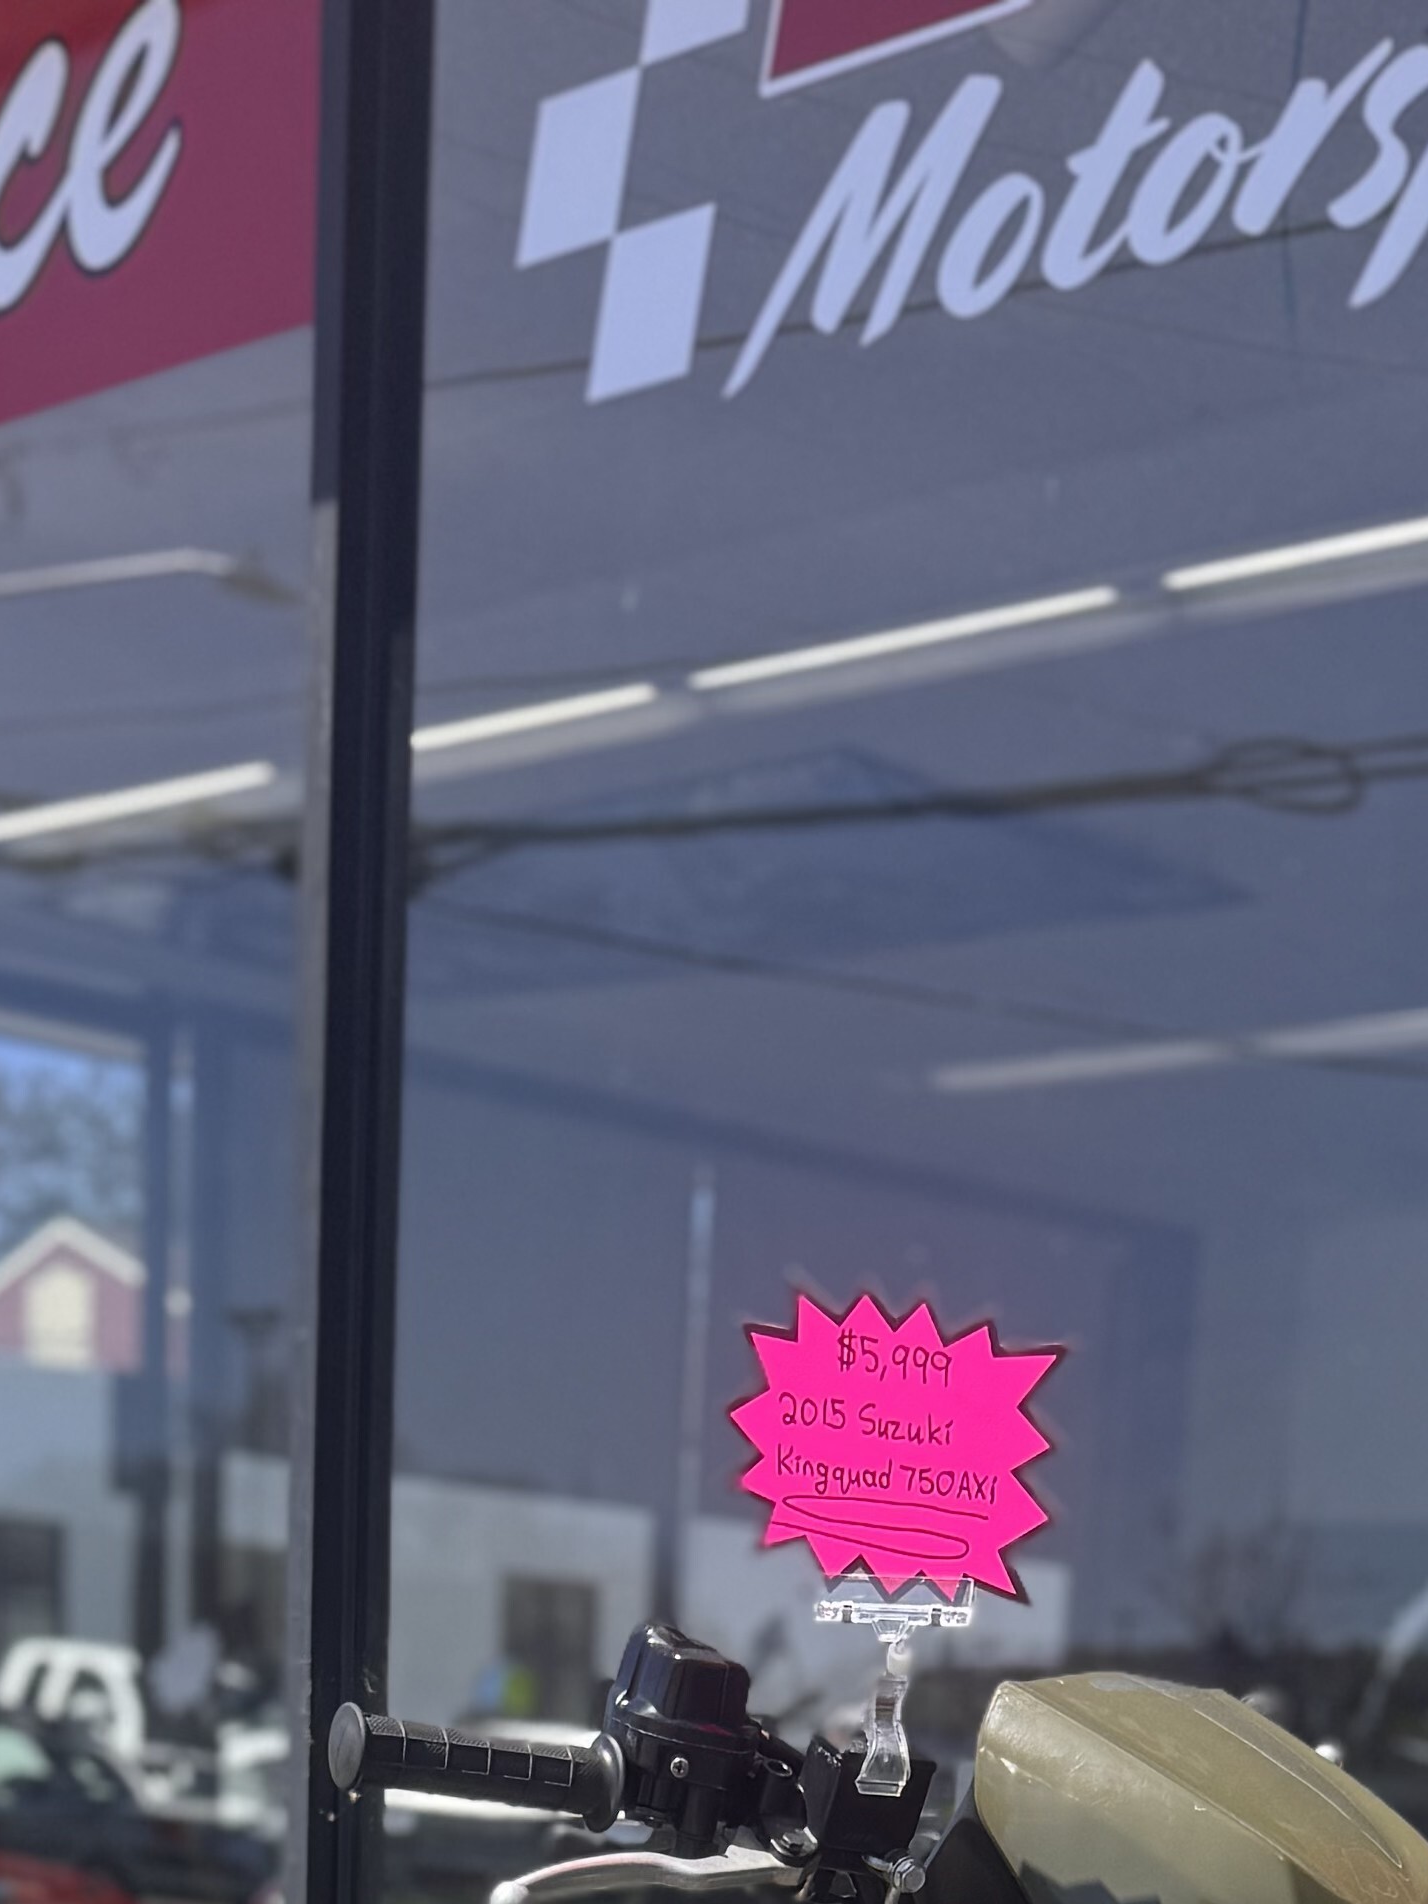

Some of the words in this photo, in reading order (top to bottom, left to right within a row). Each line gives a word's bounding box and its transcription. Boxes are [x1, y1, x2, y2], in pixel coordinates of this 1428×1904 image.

[837, 1327, 953, 1388] $5,999
[777, 1391, 847, 1430] 2015
[857, 1403, 955, 1447] Suzuki
[777, 1443, 893, 1495] Kingquad
